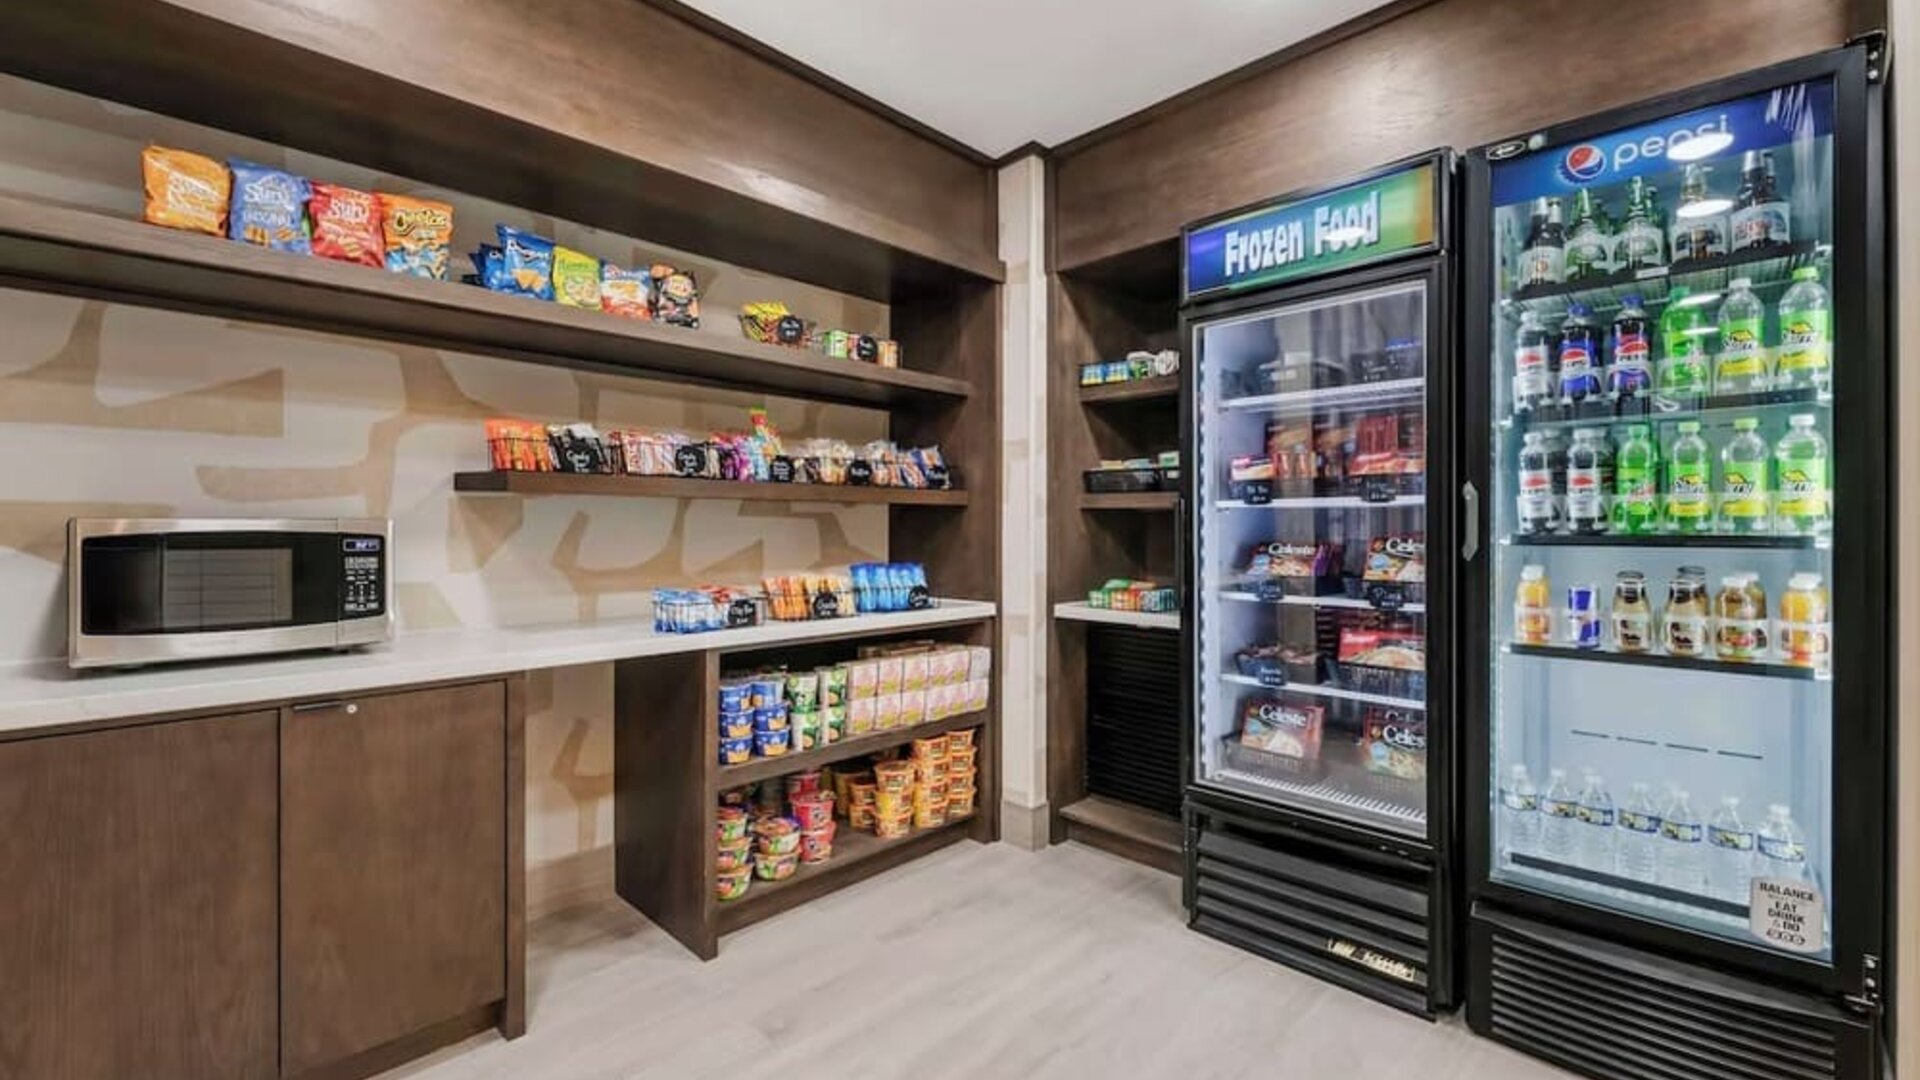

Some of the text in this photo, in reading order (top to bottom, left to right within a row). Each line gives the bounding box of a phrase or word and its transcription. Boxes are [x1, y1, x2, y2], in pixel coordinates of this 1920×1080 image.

[1224, 191, 1379, 276] Frozen Food
[1259, 704, 1307, 727] Celeste
[1759, 882, 1814, 902] BALANCE
